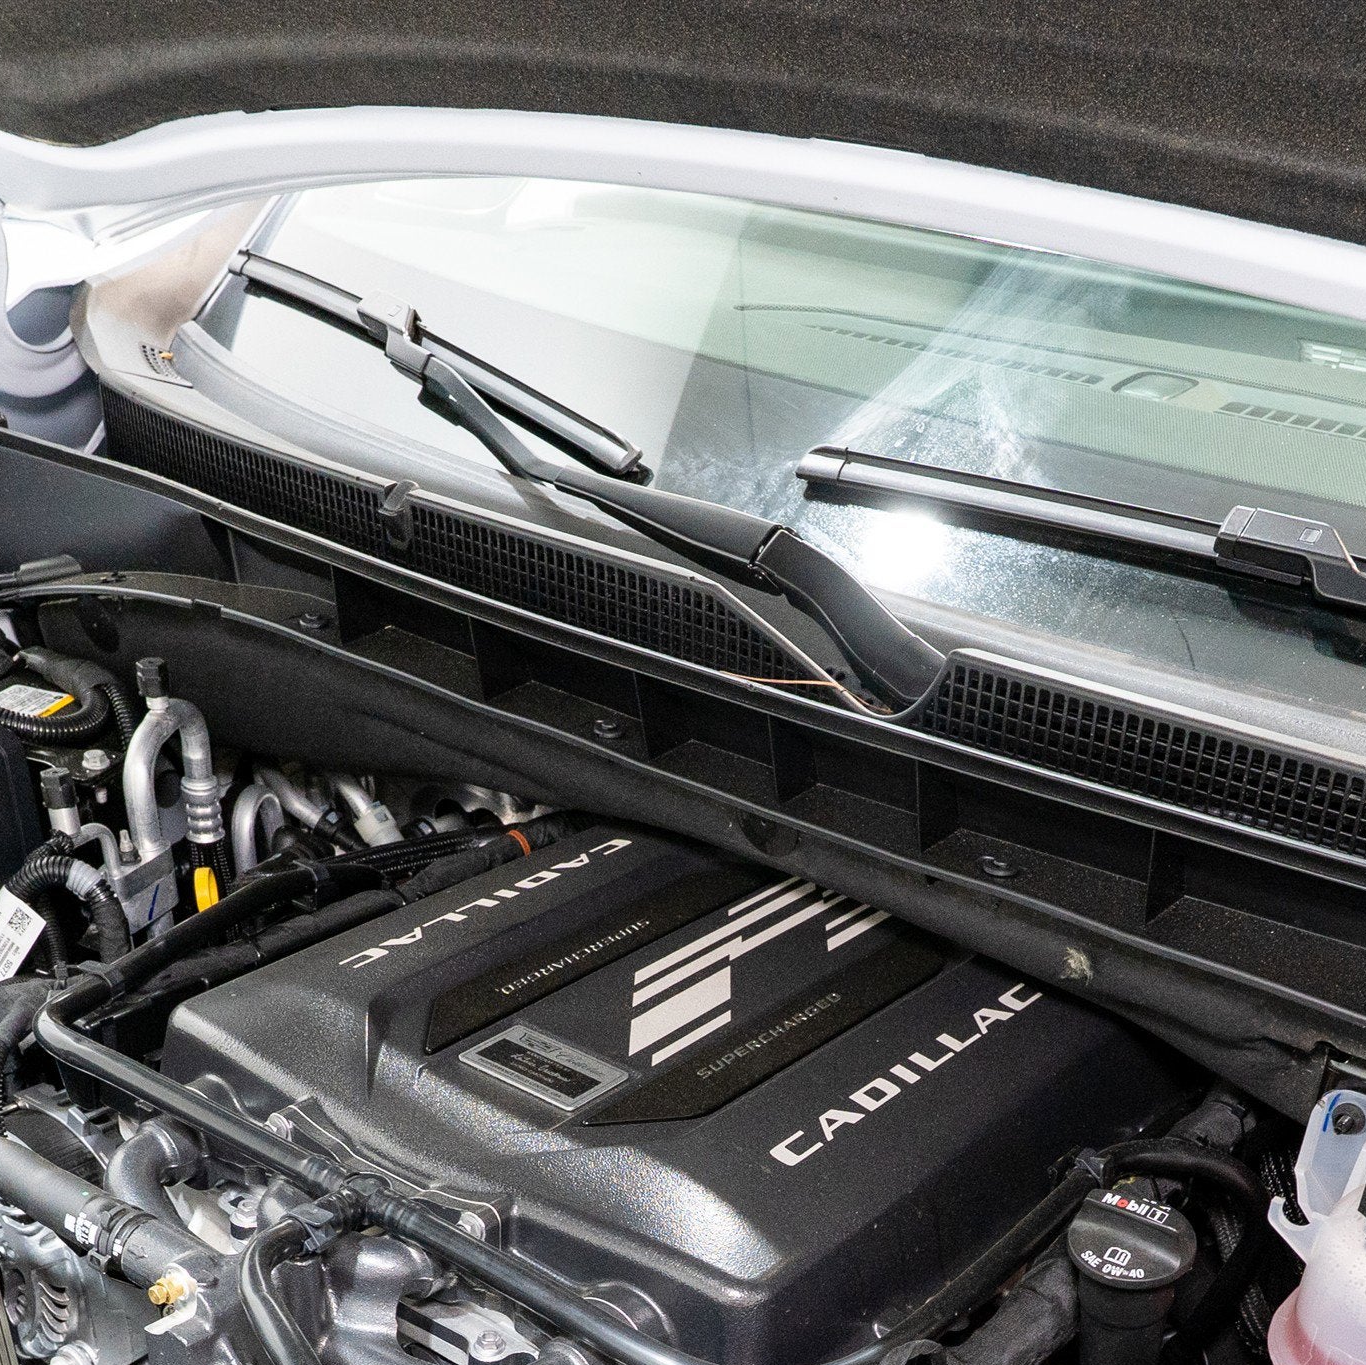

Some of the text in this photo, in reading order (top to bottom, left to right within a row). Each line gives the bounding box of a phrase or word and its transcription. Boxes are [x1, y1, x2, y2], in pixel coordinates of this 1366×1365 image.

[338, 838, 633, 969] CADILLAC
[696, 992, 842, 1080] SUPERCHARGED
[769, 982, 1043, 1167] CADILLAC
[1101, 1192, 1151, 1216] Mobil
[1080, 1250, 1145, 1279] SAE 0W-40
